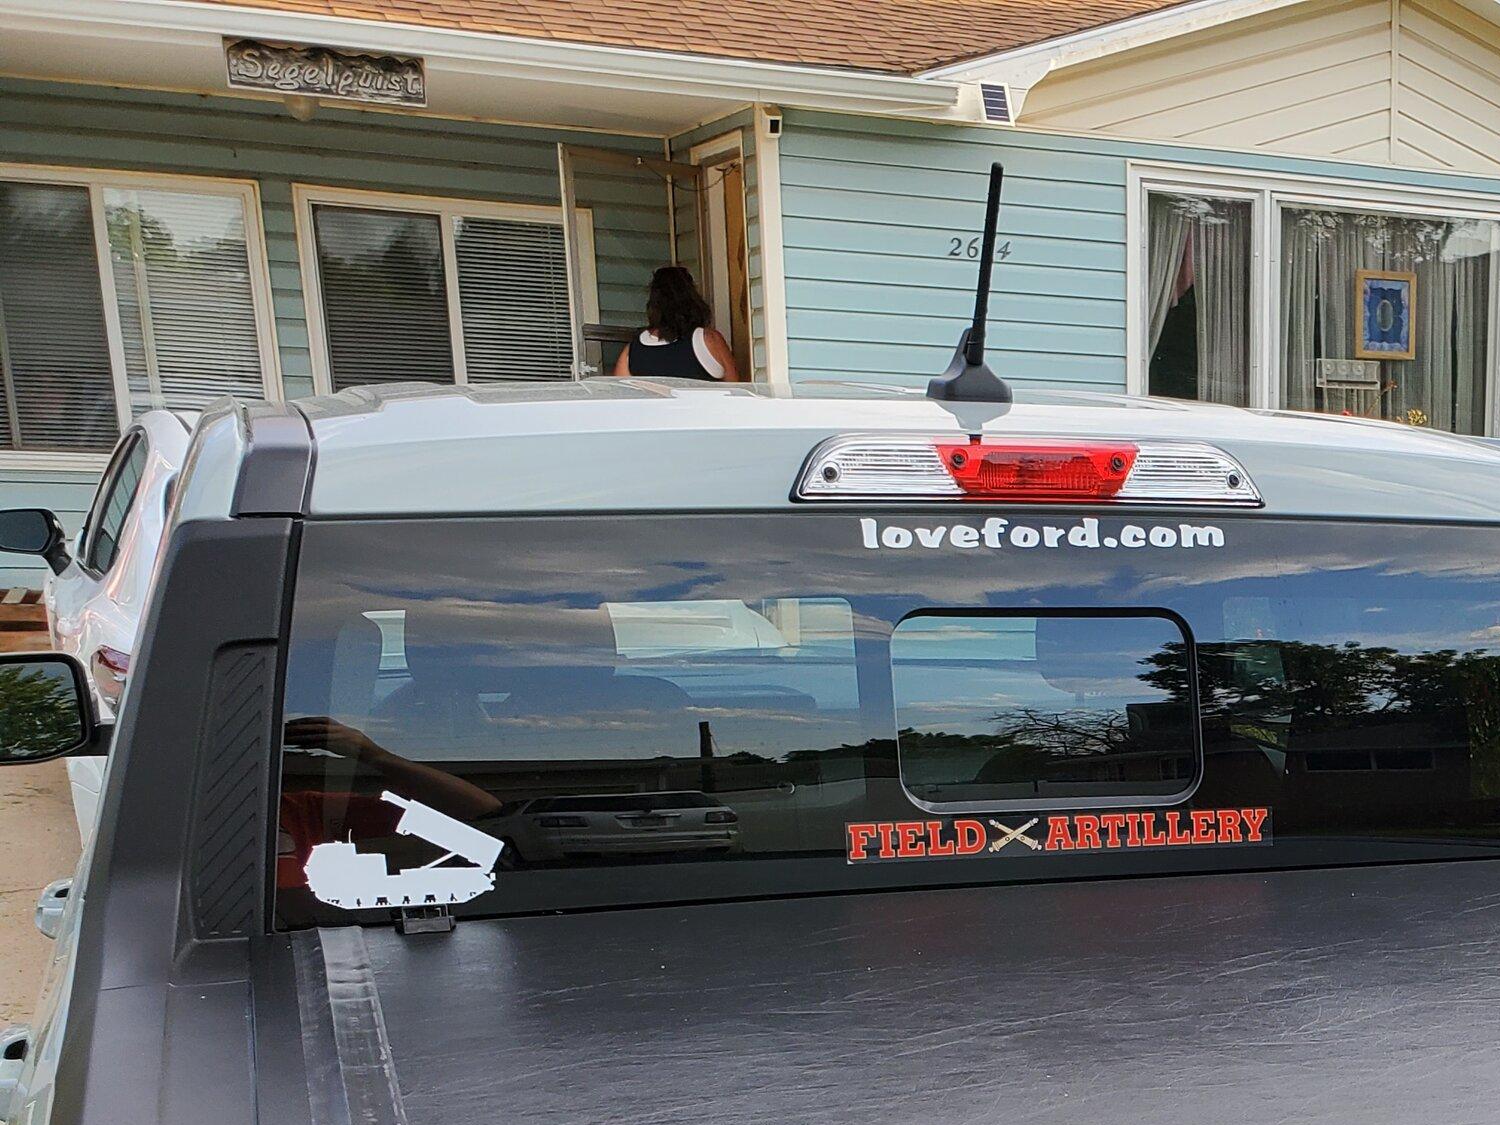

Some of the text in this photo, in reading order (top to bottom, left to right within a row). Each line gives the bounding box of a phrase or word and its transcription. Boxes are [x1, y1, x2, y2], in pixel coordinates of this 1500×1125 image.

[948, 237, 1012, 260] 264
[860, 517, 1224, 549] loveford.com
[848, 808, 1268, 860] FIELD ARTILLERY
